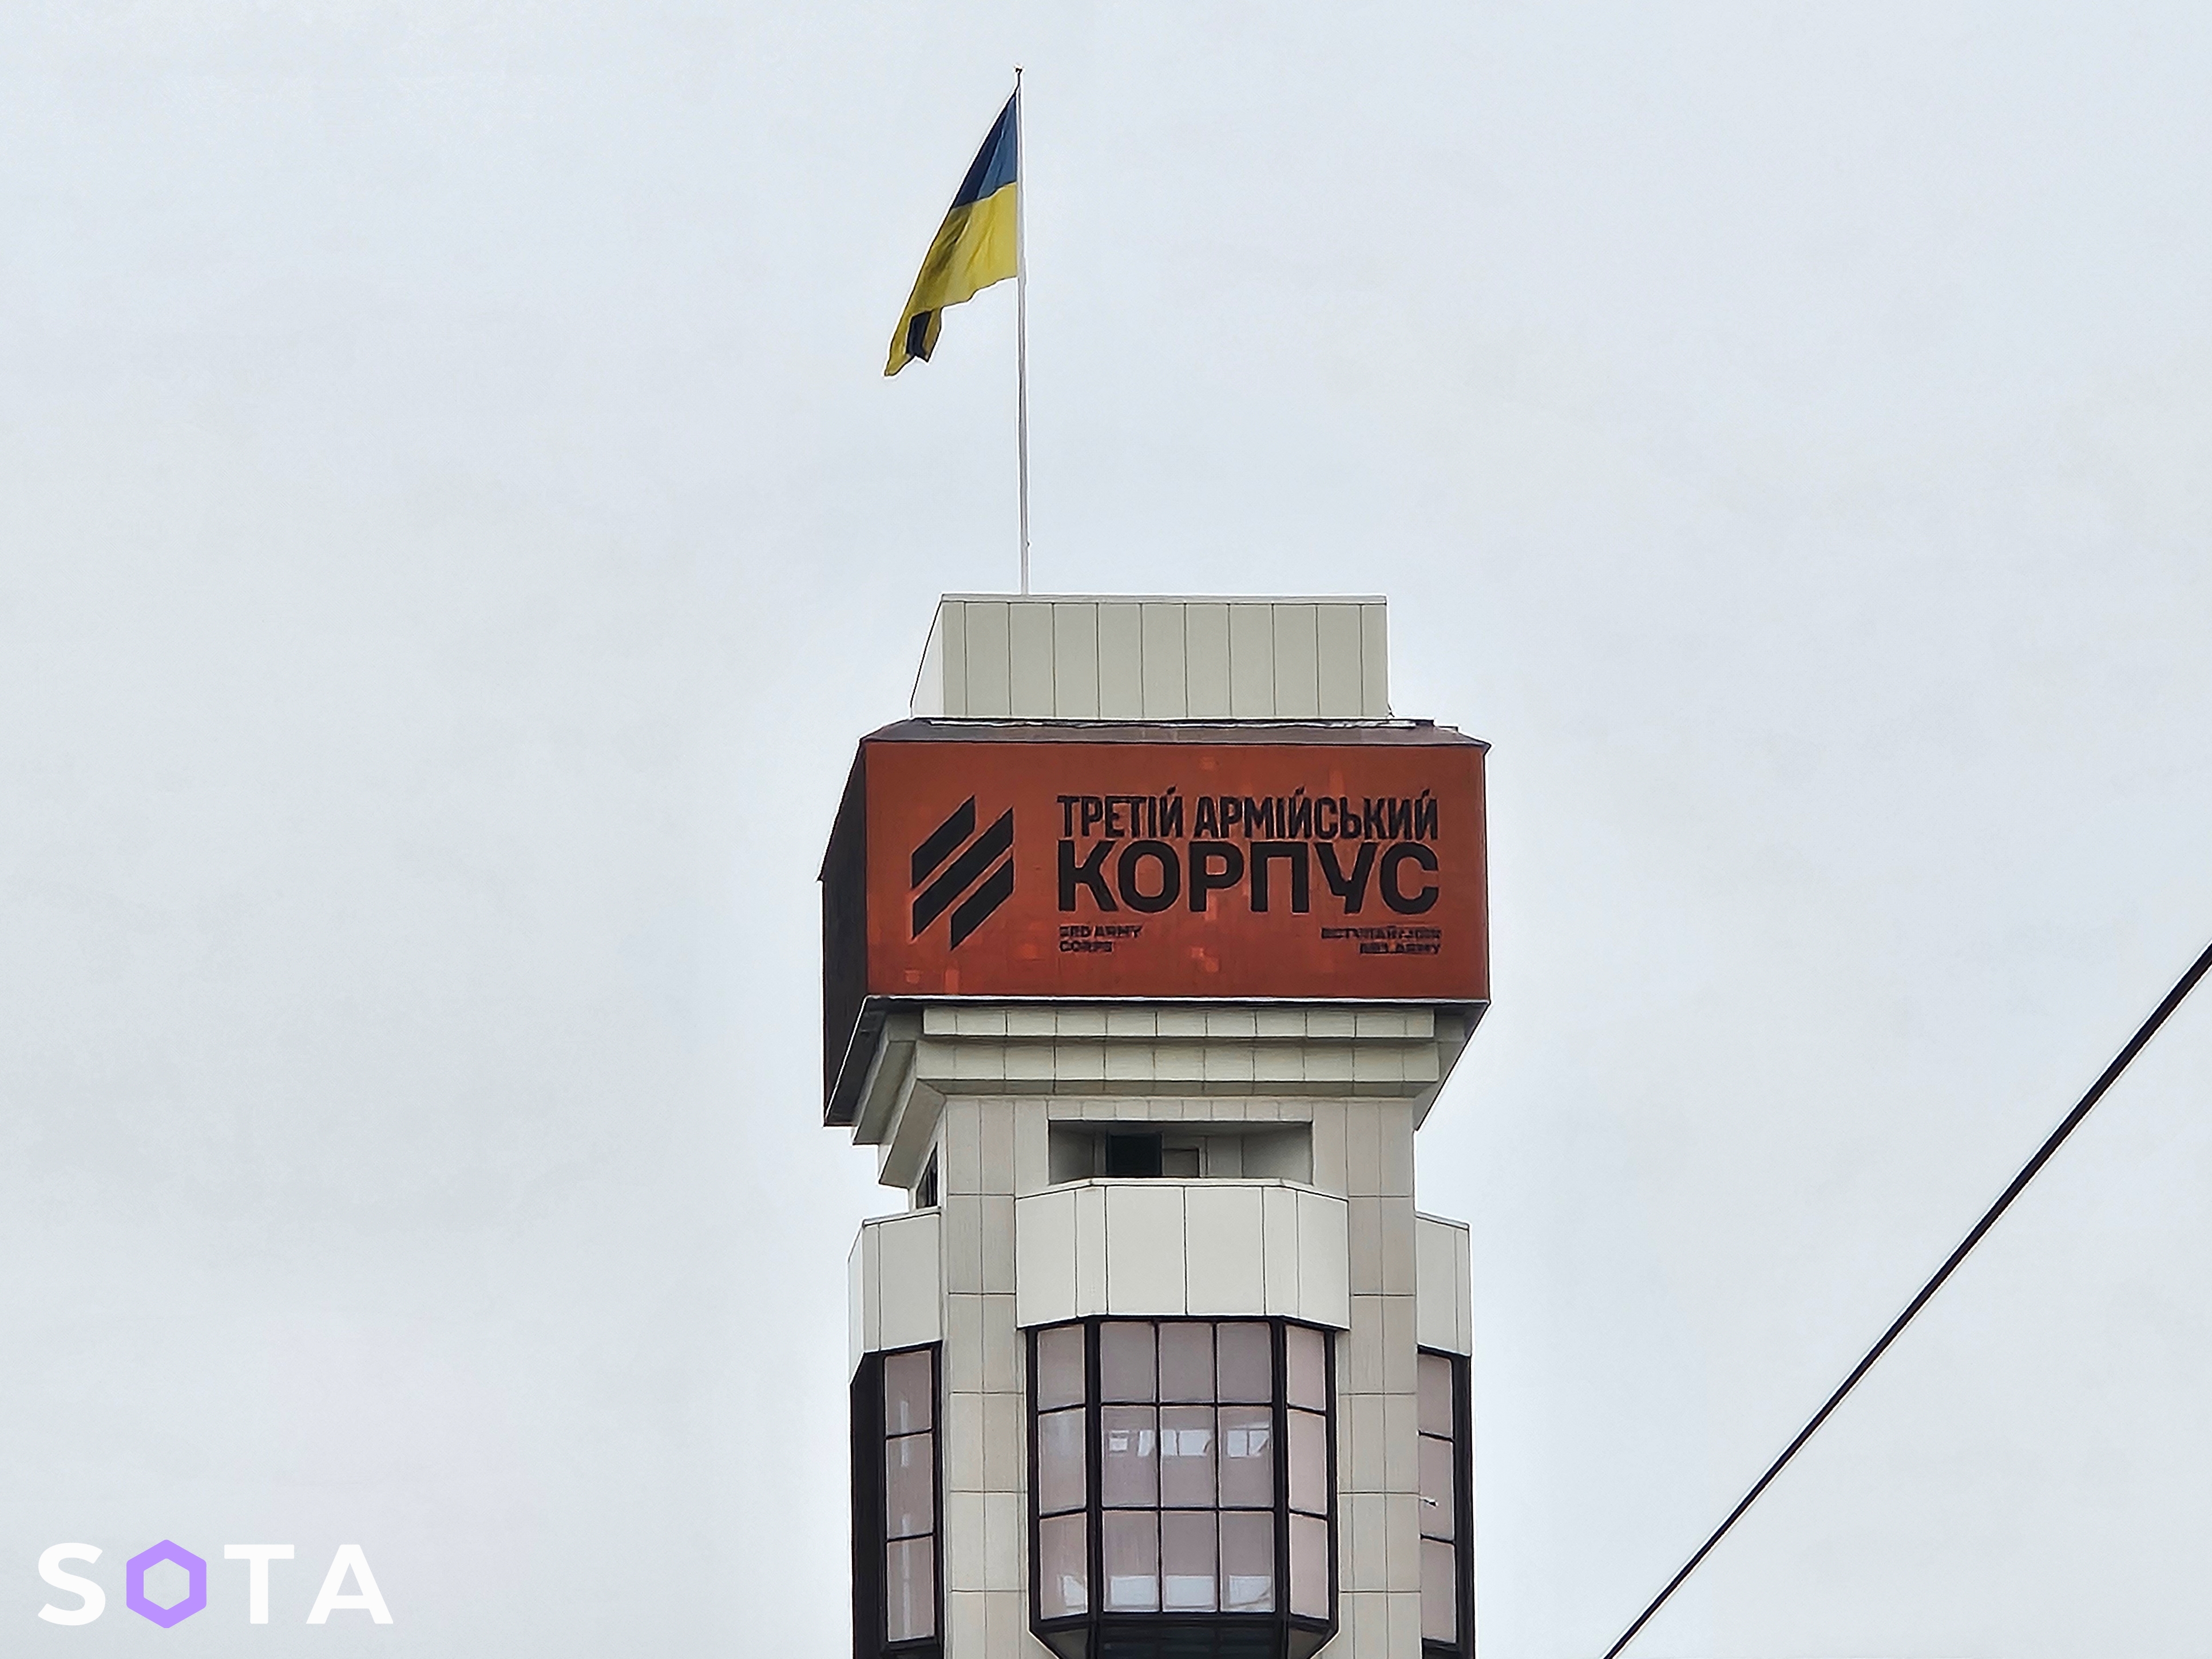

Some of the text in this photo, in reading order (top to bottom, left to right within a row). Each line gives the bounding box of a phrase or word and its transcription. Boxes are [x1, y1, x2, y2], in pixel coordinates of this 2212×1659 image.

[1057, 785, 1438, 840] ТРЕТІЙ АРМІЙСЬКИЙ
[1058, 839, 1438, 914] КОРПУС
